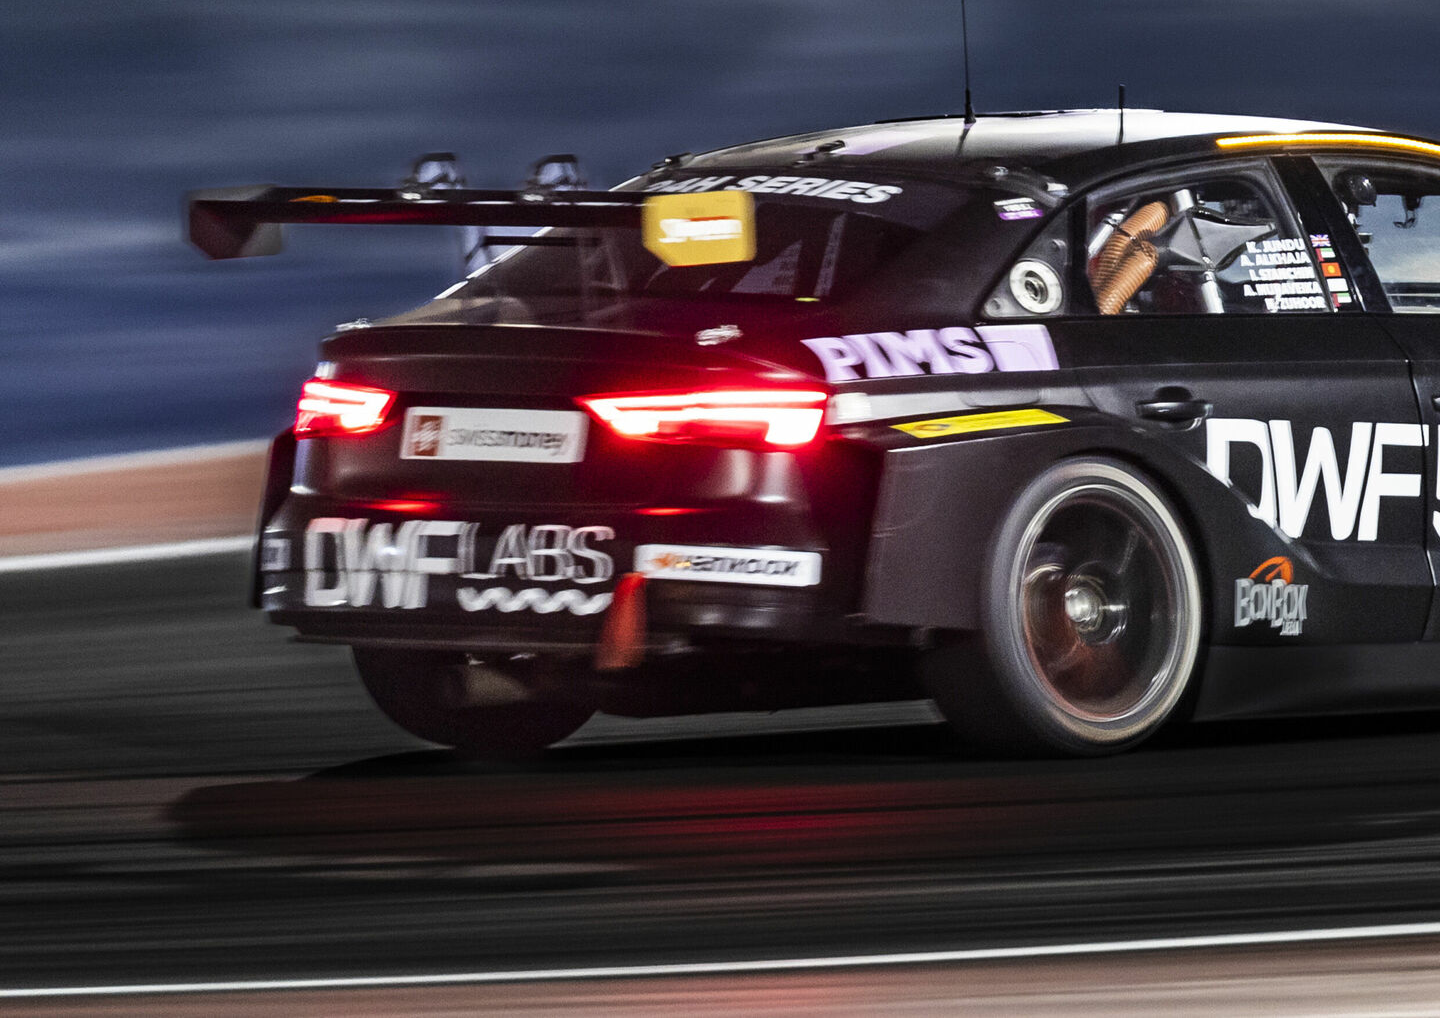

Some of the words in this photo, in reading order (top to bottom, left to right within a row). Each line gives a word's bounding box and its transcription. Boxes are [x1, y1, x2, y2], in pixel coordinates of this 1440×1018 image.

[724, 175, 904, 204] SERIES
[1262, 238, 1306, 253] JUNDU
[800, 326, 996, 382] PIMS
[1206, 417, 1430, 542] DWF
[304, 518, 464, 609] DWF
[457, 522, 616, 584] LABS
